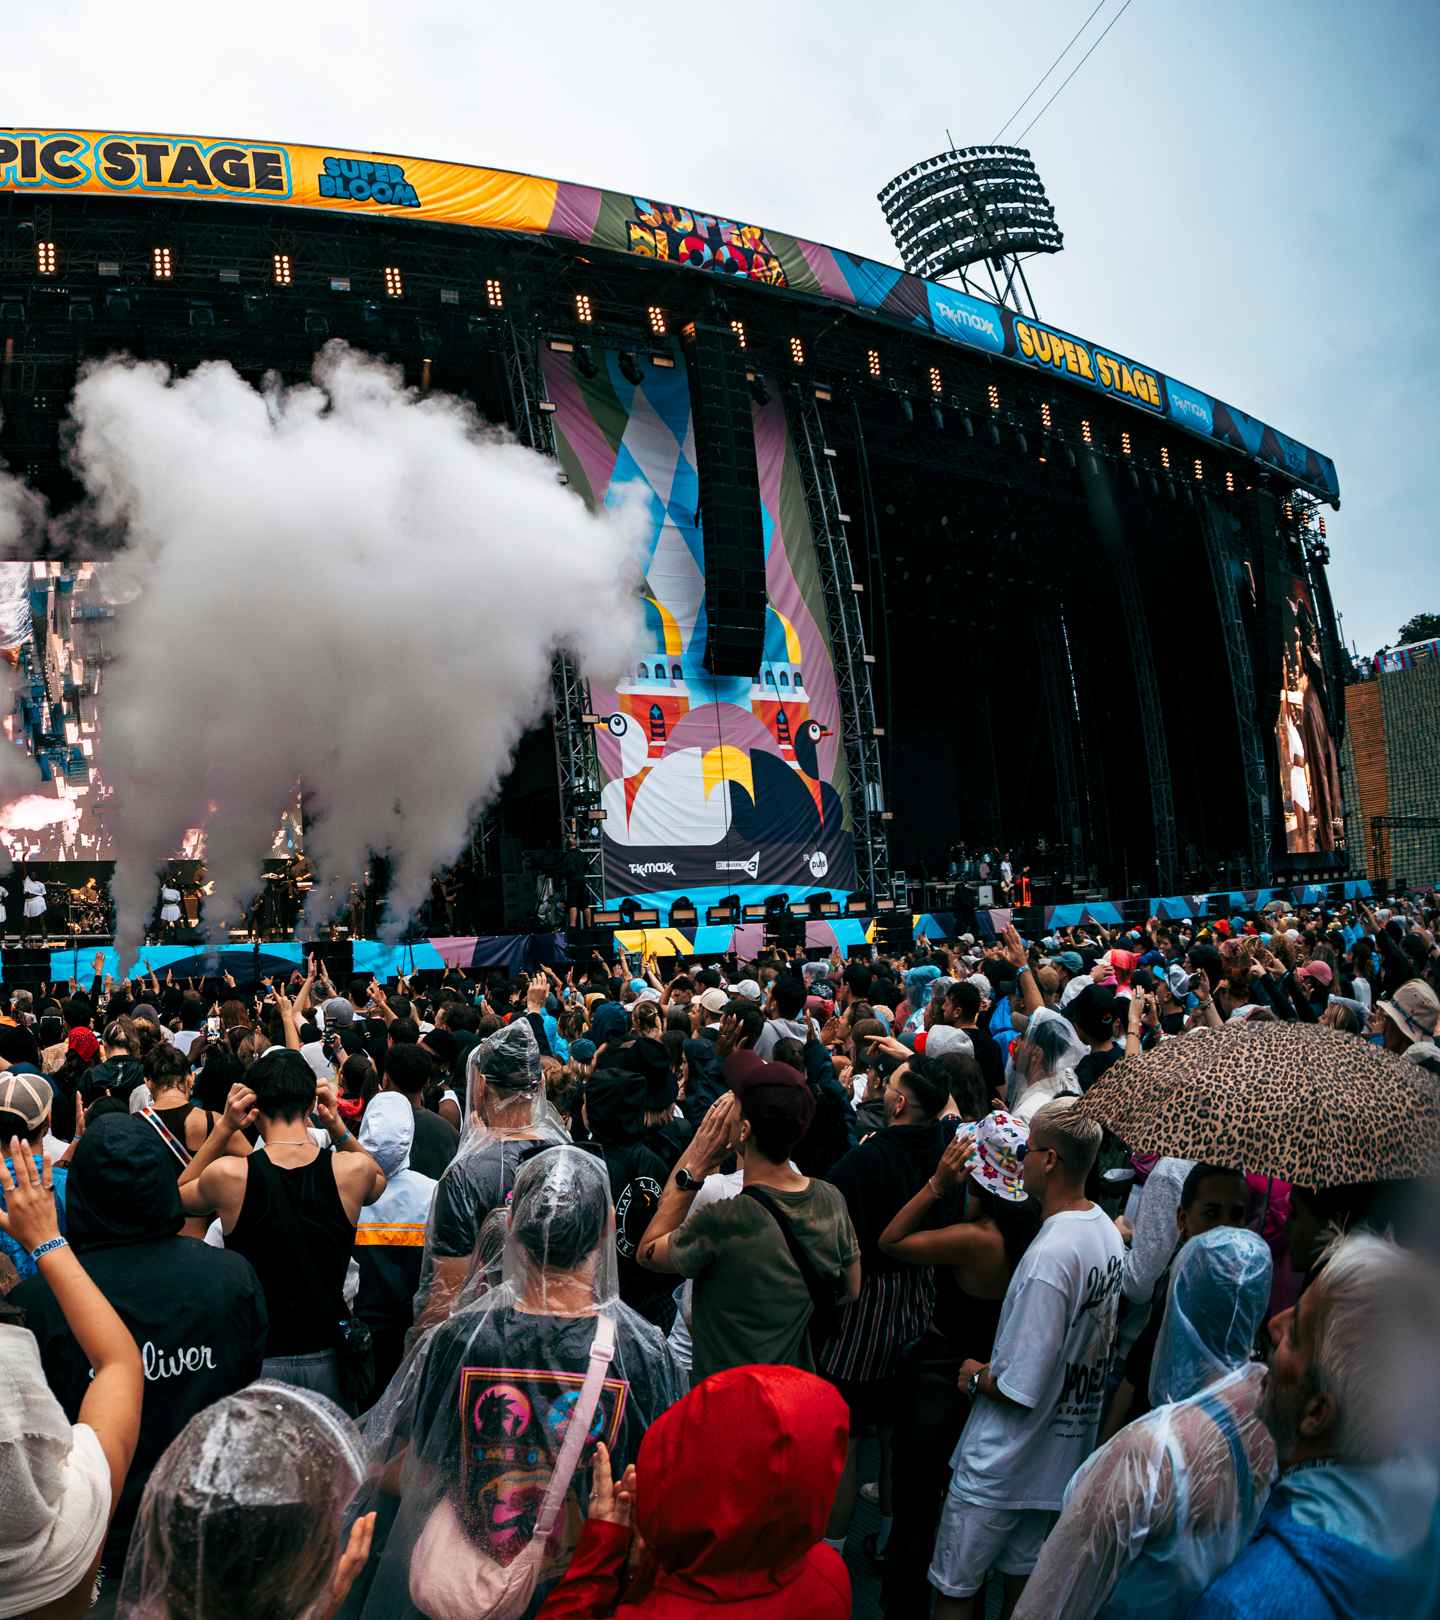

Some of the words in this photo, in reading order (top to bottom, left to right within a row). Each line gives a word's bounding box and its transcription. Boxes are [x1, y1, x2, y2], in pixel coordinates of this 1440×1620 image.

[103, 142, 284, 190] STAGE
[323, 157, 407, 186] SUPER
[318, 175, 421, 207] BLOOM
[634, 197, 775, 254] SUPER
[1016, 321, 1095, 381] SUPER
[1096, 352, 1161, 407] STAGE
[747, 861, 757, 871] 3
